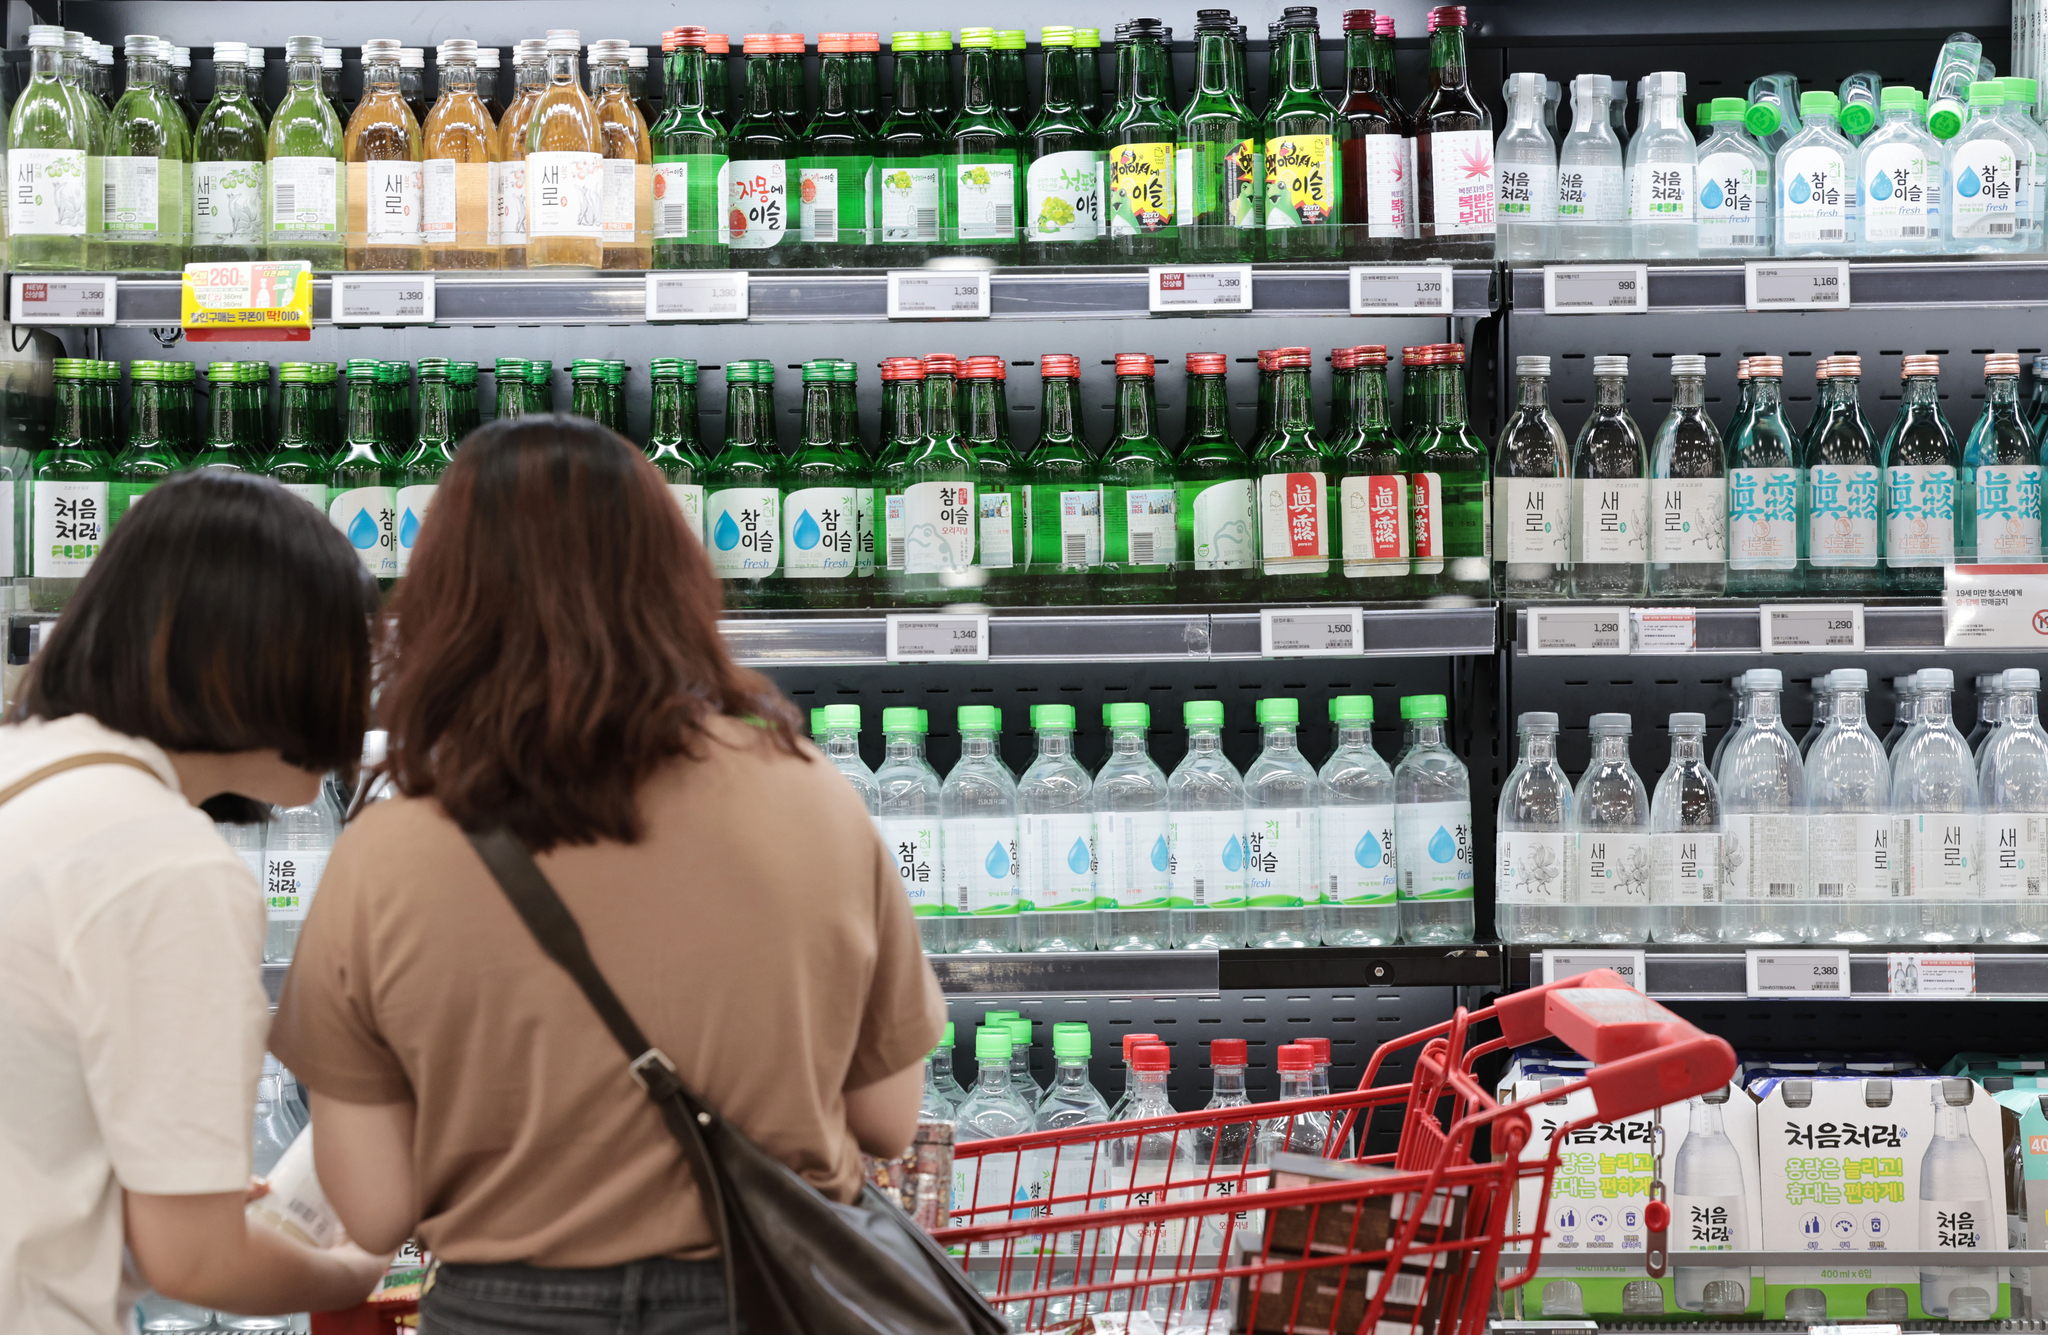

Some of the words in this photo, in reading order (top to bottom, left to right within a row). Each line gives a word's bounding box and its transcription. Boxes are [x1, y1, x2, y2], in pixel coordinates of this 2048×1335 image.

[1502, 171, 1530, 186] 처음
[1561, 172, 1584, 188] 처음
[1651, 171, 1682, 186] 처음
[1811, 172, 1827, 189] 참
[1893, 168, 1910, 186] 참
[1981, 165, 1998, 183] 참
[17, 163, 34, 205] 새로
[542, 165, 558, 206] 새로
[736, 175, 783, 203] 자몽에
[1133, 178, 1163, 208] 이슬
[1293, 170, 1323, 201] 이슬
[1724, 178, 1740, 195] 참
[1894, 184, 1923, 202] 이슬
[1982, 181, 2011, 199] 이슬
[197, 176, 210, 216] 새로
[384, 174, 402, 215] 새로
[1458, 192, 1494, 208] 복받은
[1501, 186, 1529, 202] 처럼
[1559, 188, 1583, 203] 처럼
[1651, 186, 1682, 201] 처럼
[1724, 194, 1752, 211] 이슬
[1812, 187, 1840, 205] 이슬
[749, 200, 781, 230] 이슬
[1303, 209, 1320, 217] sugar
[1816, 209, 1838, 218] fresh
[1898, 206, 1921, 215] fresh
[1985, 203, 2008, 212] fresh
[1142, 217, 1160, 225] sugar
[1459, 208, 1495, 226] 부라더
[1728, 214, 1750, 224] fresh
[210, 267, 239, 286] 260
[1218, 279, 1240, 287] 1,390
[1618, 281, 1636, 290] 990
[1813, 277, 1838, 287] 1,160
[81, 291, 104, 300] 1,390
[399, 291, 423, 301] 1,390
[712, 289, 736, 298] 1,390
[954, 286, 978, 296] 1,390
[1416, 283, 1441, 292] 1,370
[238, 311, 265, 322] 쿠폰이
[939, 488, 957, 506] 참
[54, 497, 97, 520] 처음
[940, 506, 969, 525] 이슬
[1525, 491, 1544, 532] 새로
[1600, 491, 1619, 532] 새로
[1664, 490, 1682, 532] 새로
[379, 508, 395, 531] 참
[740, 509, 760, 531] 참
[821, 509, 840, 531] 참
[55, 520, 98, 541] 처럼
[942, 527, 968, 535] 오리지널
[380, 531, 397, 551] 이
[741, 530, 774, 553] 이슬
[822, 530, 852, 553] 이슬
[1742, 539, 1784, 551] 진로골드
[1822, 537, 1865, 549] 진로골드
[1898, 538, 1941, 550] 진로골드
[1994, 538, 2034, 550] 진로골드
[381, 558, 397, 570] fres
[743, 558, 769, 570] fresh
[823, 558, 849, 570] fresh
[1956, 589, 1972, 597] 19세
[1973, 589, 1987, 597] 미만
[1988, 588, 2022, 597] 청소년에게
[1980, 598, 2008, 606] 판매금지
[952, 630, 977, 639] 1,340
[1327, 624, 1352, 634] 1,500
[1594, 623, 1618, 633] 1,290
[1827, 621, 1852, 630] 1,290
[1250, 832, 1264, 853] 참
[1456, 824, 1468, 845] 참
[898, 842, 917, 863] 참
[1874, 829, 1888, 870] 새로
[1943, 826, 1961, 866] 새로
[1999, 828, 2017, 869] 새로
[268, 860, 296, 878] 처음
[1250, 851, 1279, 873] 이슬
[1590, 843, 1605, 878] 새로
[1680, 843, 1697, 879] 새로
[900, 861, 931, 882] 이슬
[268, 878, 297, 893] 처럼
[1251, 878, 1271, 888] fresh
[1813, 966, 1838, 976] 2,380
[1784, 1121, 1902, 1150] 처음처럼
[1785, 1158, 1841, 1180] 용량은
[1842, 1157, 1904, 1178] 늘리고!
[1786, 1182, 1842, 1205] 휴대는
[1843, 1182, 1905, 1205] 편하게!
[1691, 1206, 1728, 1225] 처음
[1936, 1211, 1975, 1231] 처음
[1219, 1222, 1248, 1230] 오지널
[1692, 1225, 1730, 1243] 처럼
[1937, 1231, 1977, 1249] 처럼
[1858, 1268, 1872, 1279] 6입
